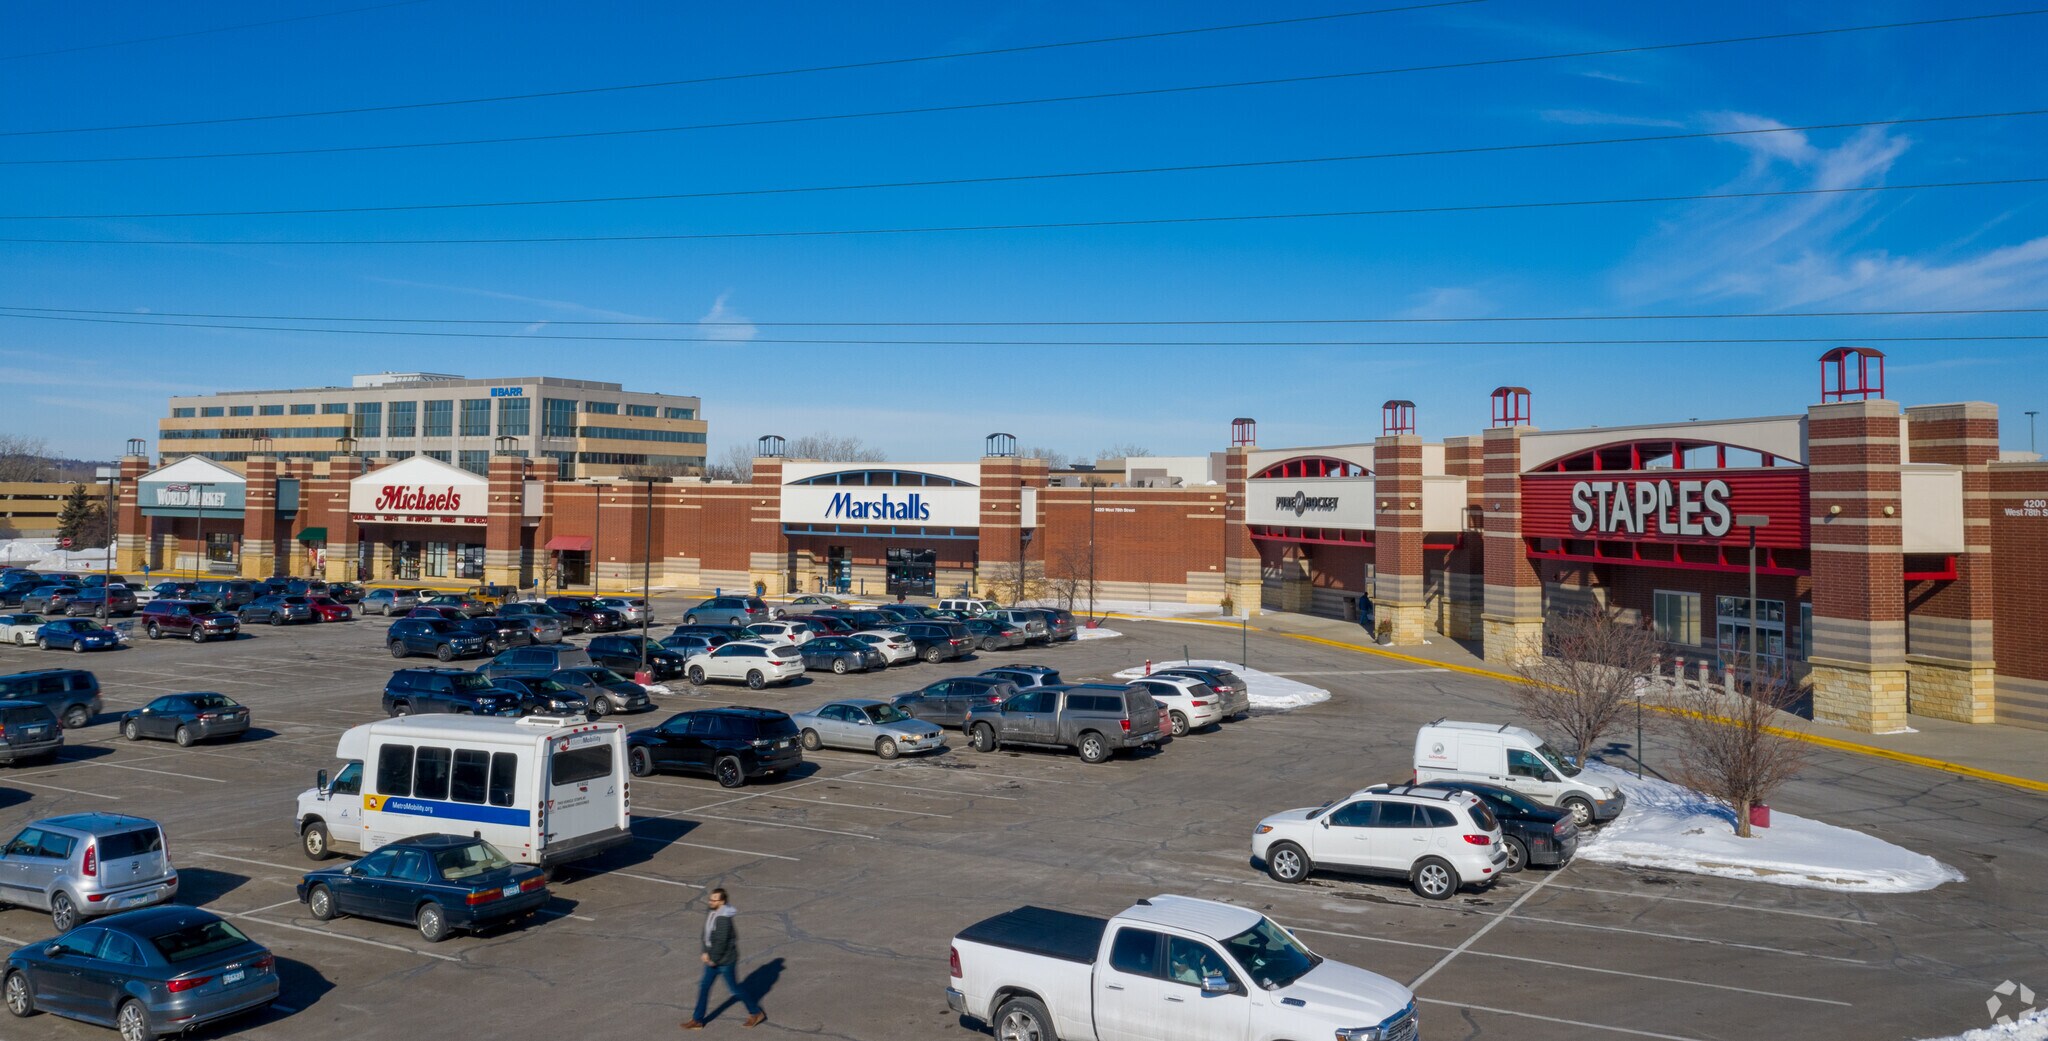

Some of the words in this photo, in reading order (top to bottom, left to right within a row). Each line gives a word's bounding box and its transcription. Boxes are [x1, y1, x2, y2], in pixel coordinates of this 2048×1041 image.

[498, 387, 522, 397] BARR
[157, 488, 187, 506] WORLD
[188, 489, 226, 507] MARKET
[375, 485, 461, 511] Michaels
[1305, 496, 1339, 511] HOCKEY
[2023, 499, 2047, 508] 4200
[825, 492, 930, 520] Marshalls
[1571, 479, 1732, 537] STAPLES
[2004, 508, 2023, 516] West
[2024, 508, 2041, 516] 78th
[392, 801, 433, 813] MetroMobility.org
